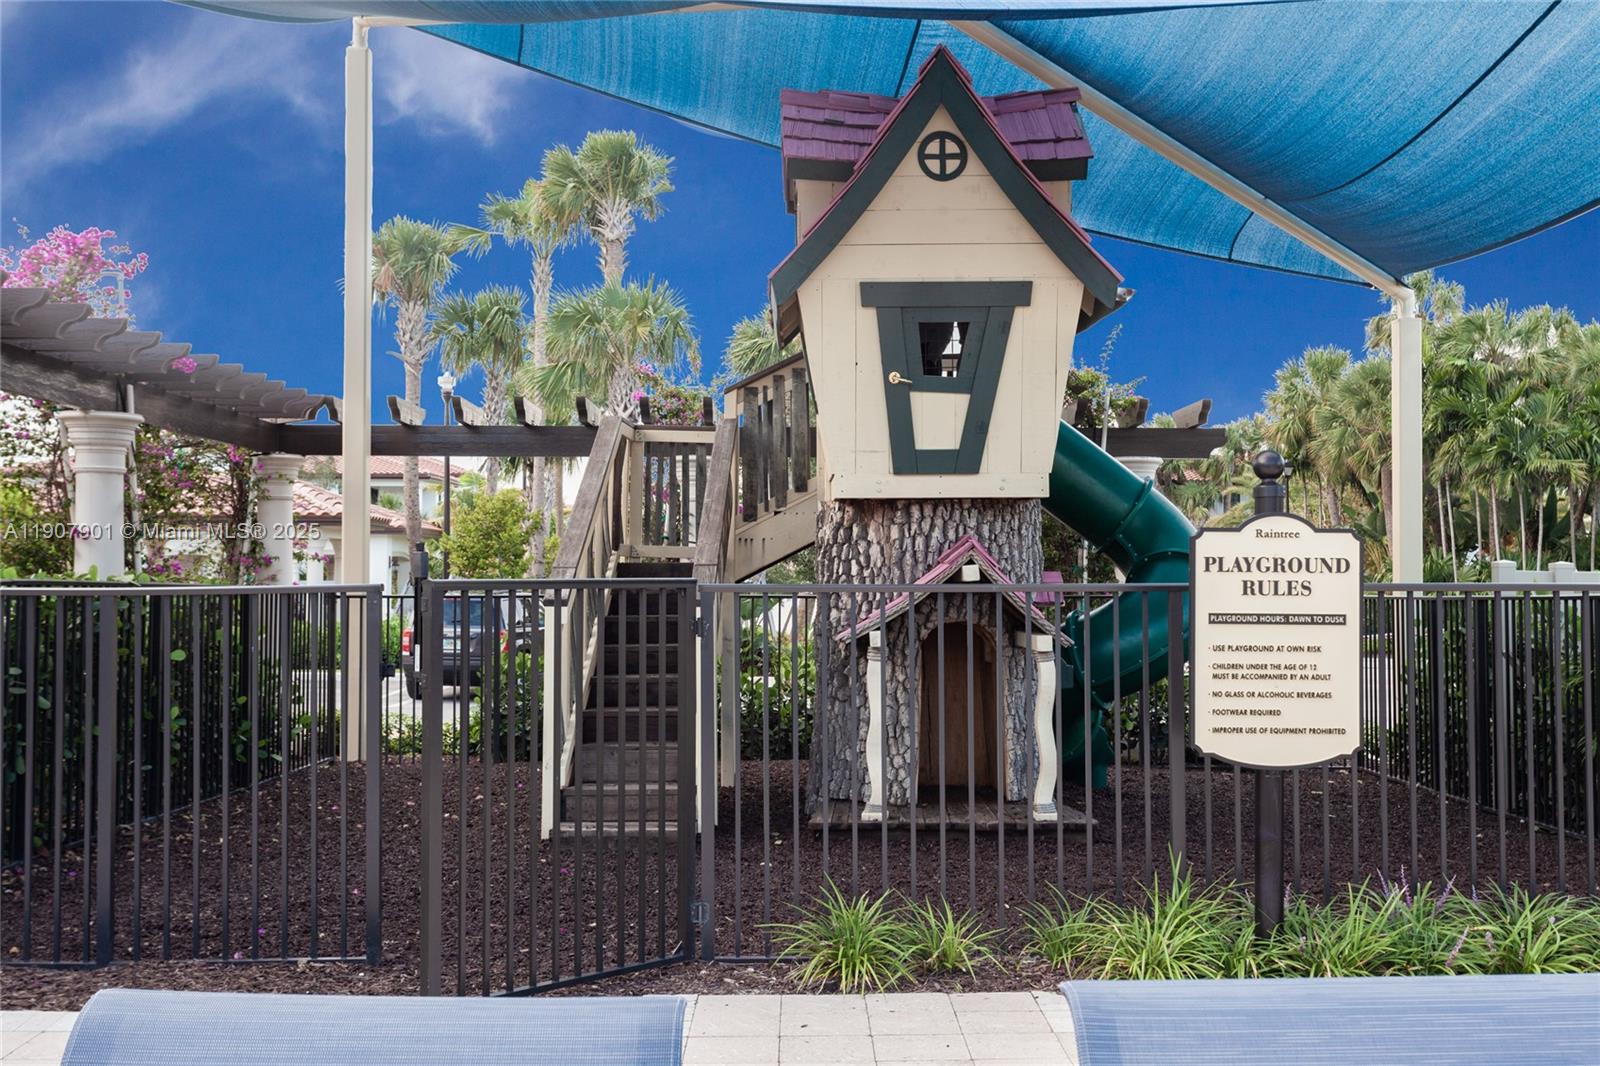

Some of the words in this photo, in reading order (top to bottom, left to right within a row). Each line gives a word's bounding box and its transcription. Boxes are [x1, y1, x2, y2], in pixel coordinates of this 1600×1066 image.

[1255, 529, 1300, 539] Raintree
[1203, 556, 1351, 574] PLAYGROUND
[1241, 579, 1312, 597] RULES
[1210, 615, 1258, 624] PLAYGROUND
[1259, 615, 1287, 624] HOURS:
[1288, 615, 1312, 624] DAWN
[1313, 615, 1323, 624] TO
[1324, 615, 1345, 624] DUSK
[1212, 645, 1225, 653] USE
[1227, 645, 1274, 653] PLAYGROUND
[1276, 645, 1285, 653] AT
[1286, 645, 1305, 653] OWN
[1306, 645, 1322, 653] RISK
[1212, 663, 1244, 671] CHILDREN
[1246, 663, 1268, 671] UNDER
[1270, 663, 1281, 671] THE
[1283, 663, 1296, 671] AGE
[1298, 663, 1307, 671] OF
[1309, 663, 1317, 671] 12
[1212, 673, 1229, 681] MUST
[1231, 673, 1239, 681] BE
[1240, 673, 1288, 681] ACCOMPANIED
[1290, 673, 1298, 681] BY
[1299, 673, 1309, 681] AN
[1310, 673, 1331, 681] ADULT
[1212, 691, 1223, 699] NO
[1224, 691, 1244, 699] GLASS
[1246, 691, 1255, 699] OR
[1257, 691, 1294, 699] ALCOHOLIC
[1296, 691, 1332, 699] BEVERAGES
[1212, 709, 1248, 717] FOOTWEAR
[1249, 709, 1282, 717] REQUIRED
[1212, 727, 1244, 735] IMPROPER
[1245, 727, 1257, 735] USE
[1258, 727, 1268, 735] OF
[1269, 727, 1307, 735] EQUIPMENT
[1308, 727, 1346, 735] PROHIBITED
